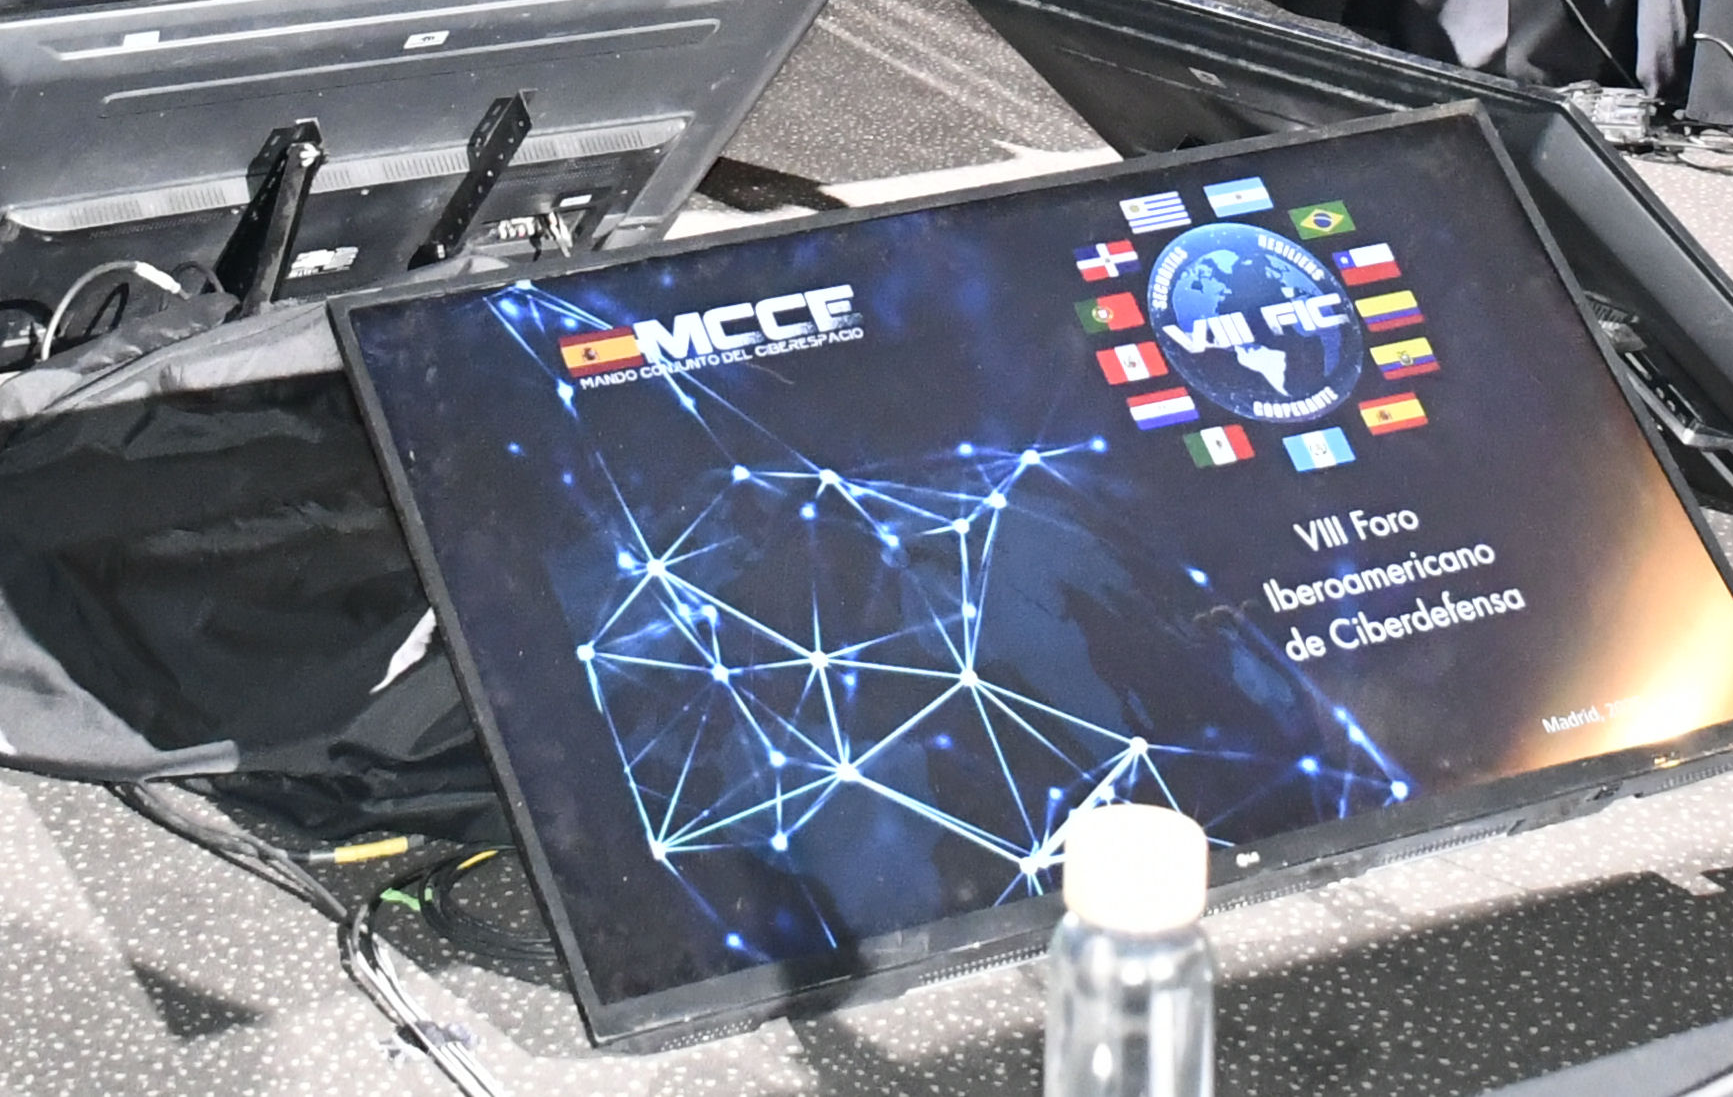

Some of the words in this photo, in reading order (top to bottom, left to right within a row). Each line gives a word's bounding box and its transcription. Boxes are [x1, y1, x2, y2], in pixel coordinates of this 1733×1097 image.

[1162, 312, 1255, 354] VIII
[1260, 293, 1350, 336] FIC
[579, 368, 638, 391] MANDO
[640, 352, 720, 379] CONJUNTO
[722, 348, 753, 365] DEL
[754, 327, 865, 358] CIBERESPACIO
[1292, 515, 1349, 552] VIII
[1349, 509, 1420, 541] Foro
[1262, 543, 1496, 613] Iberoamericano
[1285, 626, 1327, 662] de
[1329, 588, 1526, 650] Ciberdefensa
[1541, 705, 1606, 734] Madrid,
